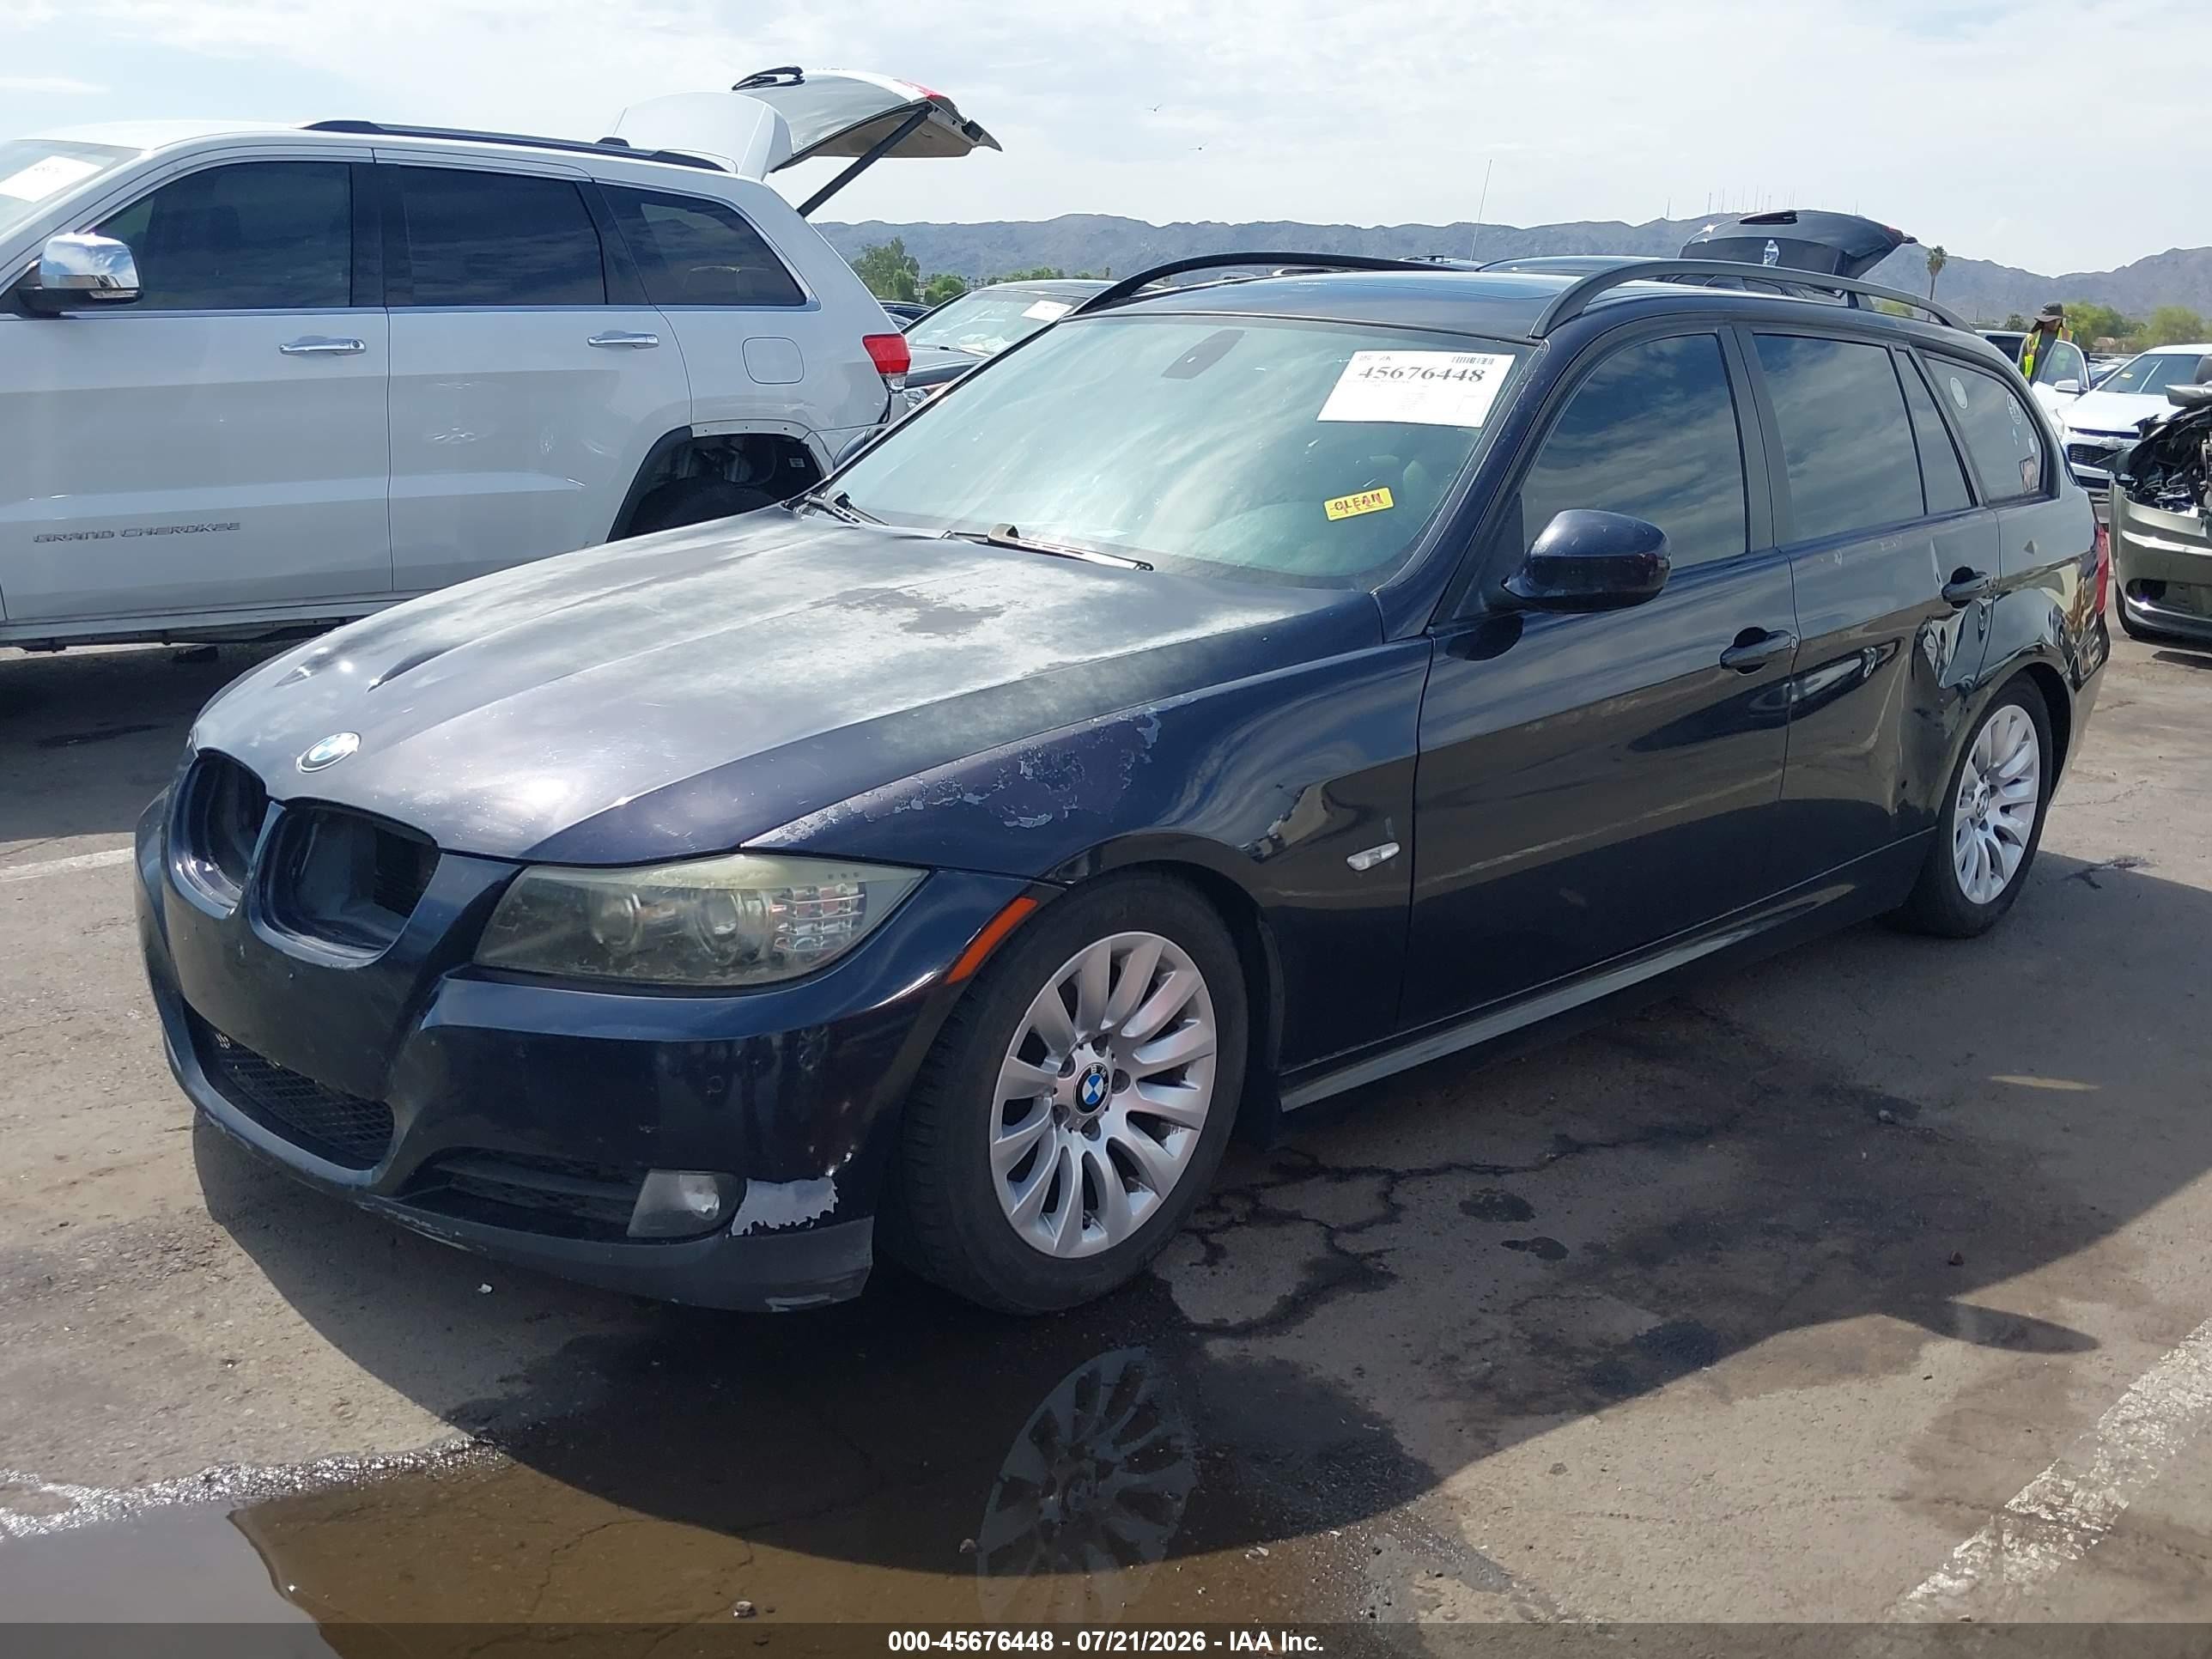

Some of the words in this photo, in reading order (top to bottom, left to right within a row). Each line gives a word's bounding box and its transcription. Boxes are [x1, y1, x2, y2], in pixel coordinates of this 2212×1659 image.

[1358, 366, 1485, 383] 45676448
[1334, 492, 1383, 513] CLEAN
[33, 530, 115, 544] GRAND
[121, 522, 241, 538] CHEROKEE
